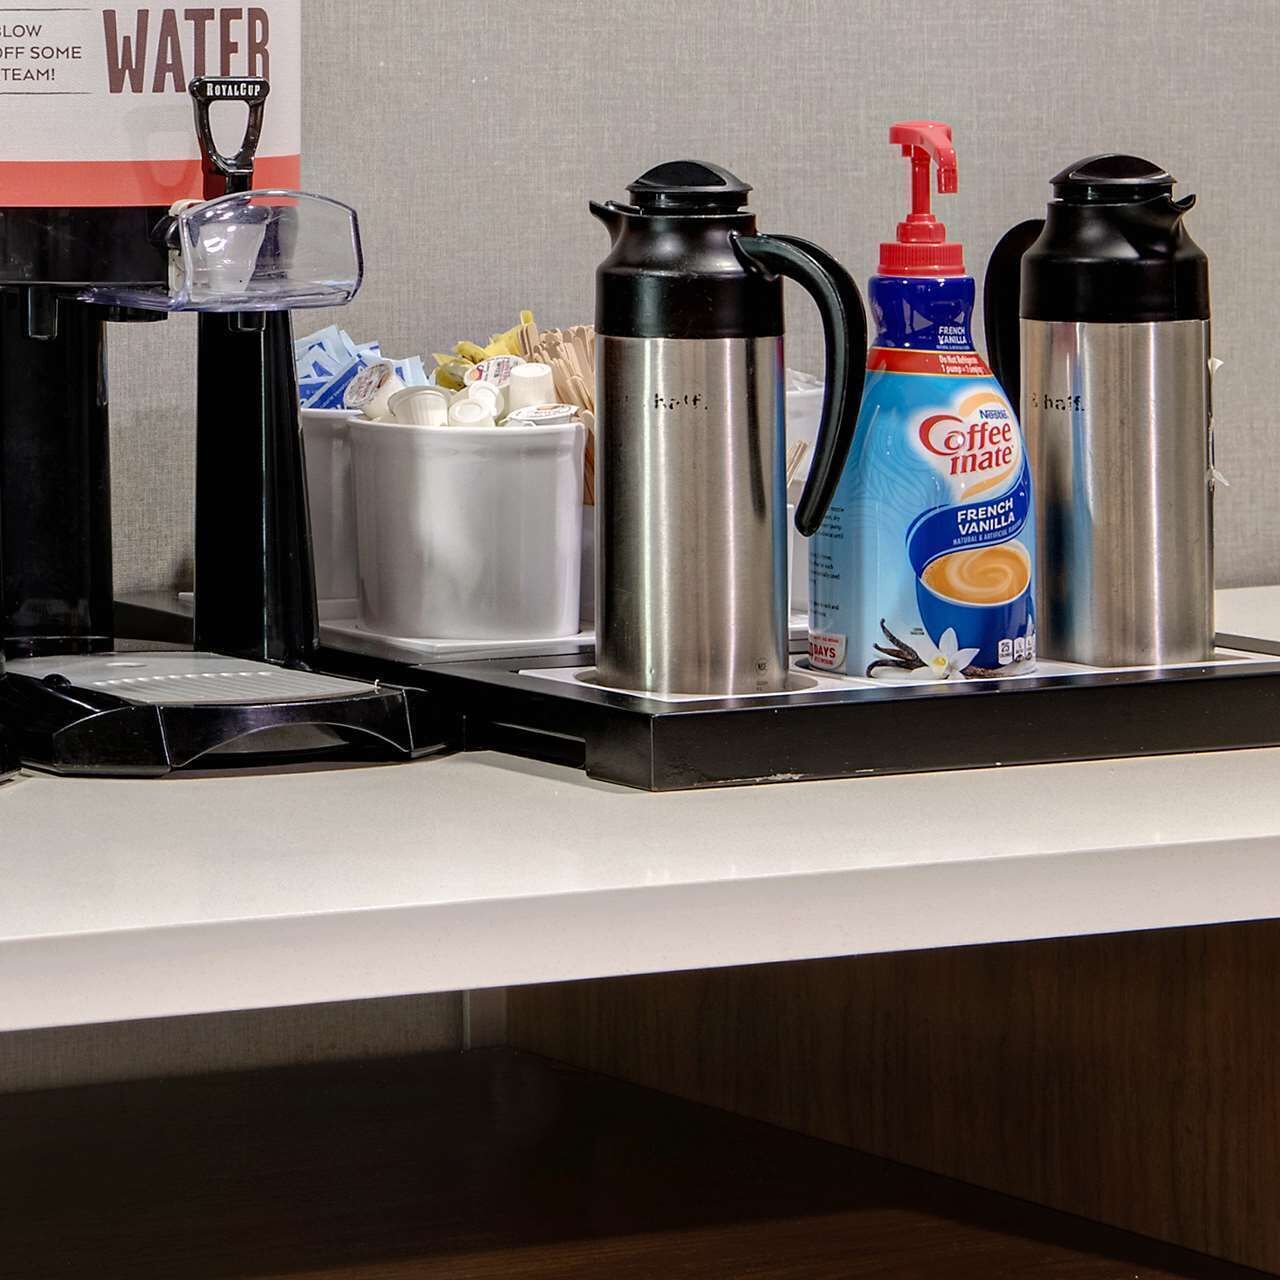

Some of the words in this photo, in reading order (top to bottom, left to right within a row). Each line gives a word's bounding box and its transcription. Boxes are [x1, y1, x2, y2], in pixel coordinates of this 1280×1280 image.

[31, 46, 81, 59] SOME
[103, 7, 270, 94] WATER
[938, 335, 968, 345] VANILLA
[939, 326, 966, 336] FRENCH
[919, 415, 1011, 456] Coffee
[949, 446, 1012, 475] mate
[957, 498, 1013, 523] FRENCH
[958, 512, 1015, 535] VANILLA
[814, 647, 836, 658] DAYS
